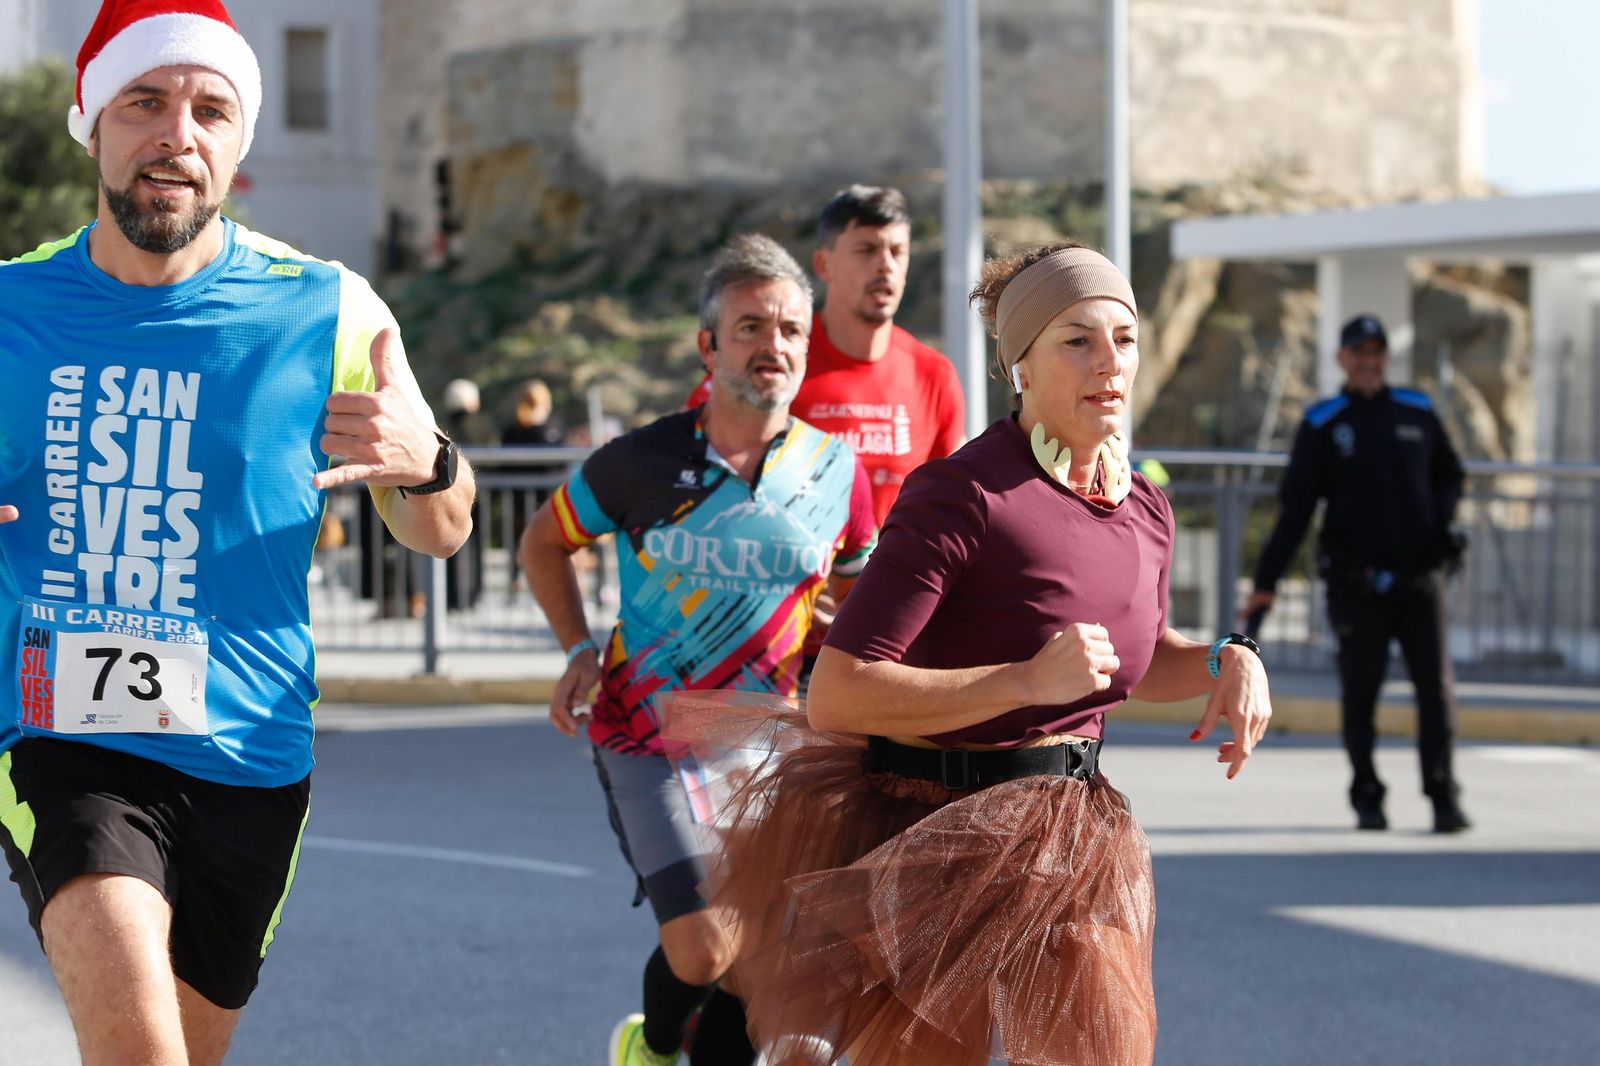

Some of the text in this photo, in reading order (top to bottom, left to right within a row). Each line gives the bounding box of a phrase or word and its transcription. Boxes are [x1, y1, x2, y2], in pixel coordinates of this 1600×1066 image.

[95, 365, 201, 421] SAN
[44, 364, 86, 555] CARRERA
[86, 414, 204, 490] SIL
[81, 484, 202, 559] VES
[77, 552, 197, 618] TRE
[688, 575, 796, 596] TRAIL TEAM
[31, 602, 202, 636] III CARRERA
[102, 624, 205, 645] TARIFA 2024
[23, 626, 51, 650] SAN
[20, 647, 48, 677] SIL
[85, 647, 163, 702] 73
[20, 675, 54, 703] VES
[20, 699, 54, 730] TRE
